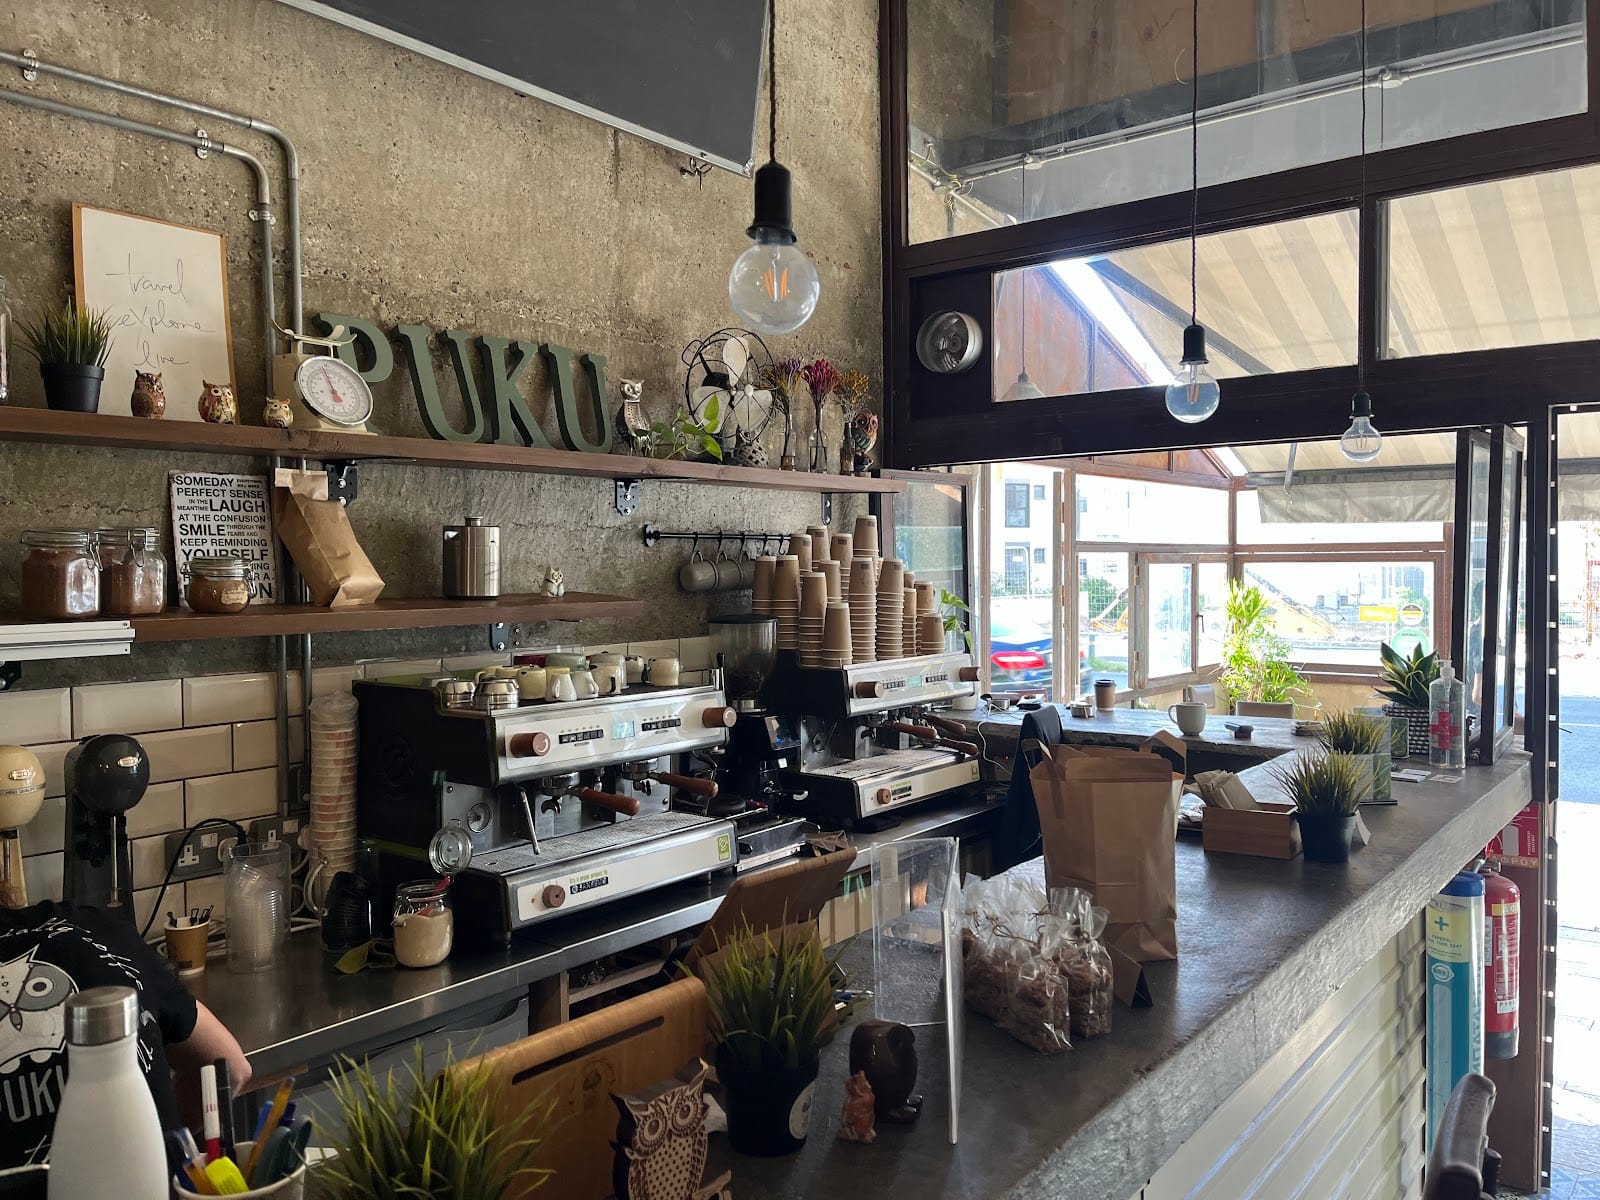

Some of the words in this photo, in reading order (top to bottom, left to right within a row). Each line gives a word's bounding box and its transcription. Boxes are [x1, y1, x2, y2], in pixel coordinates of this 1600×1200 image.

[106, 252, 188, 302] travel
[311, 312, 612, 454] PUKU
[175, 475, 234, 487] SOMEDAY
[176, 487, 226, 497] PERFECT
[229, 489, 263, 499] SENSE
[209, 499, 266, 513] LAUGH
[178, 513, 189, 522] AT
[192, 514, 210, 522] THE
[213, 514, 266, 523] CONFUSION
[179, 523, 226, 536] SMILE
[180, 538, 208, 547] KEEP
[211, 538, 268, 547] REMINDING
[181, 549, 269, 561] YOURSELF
